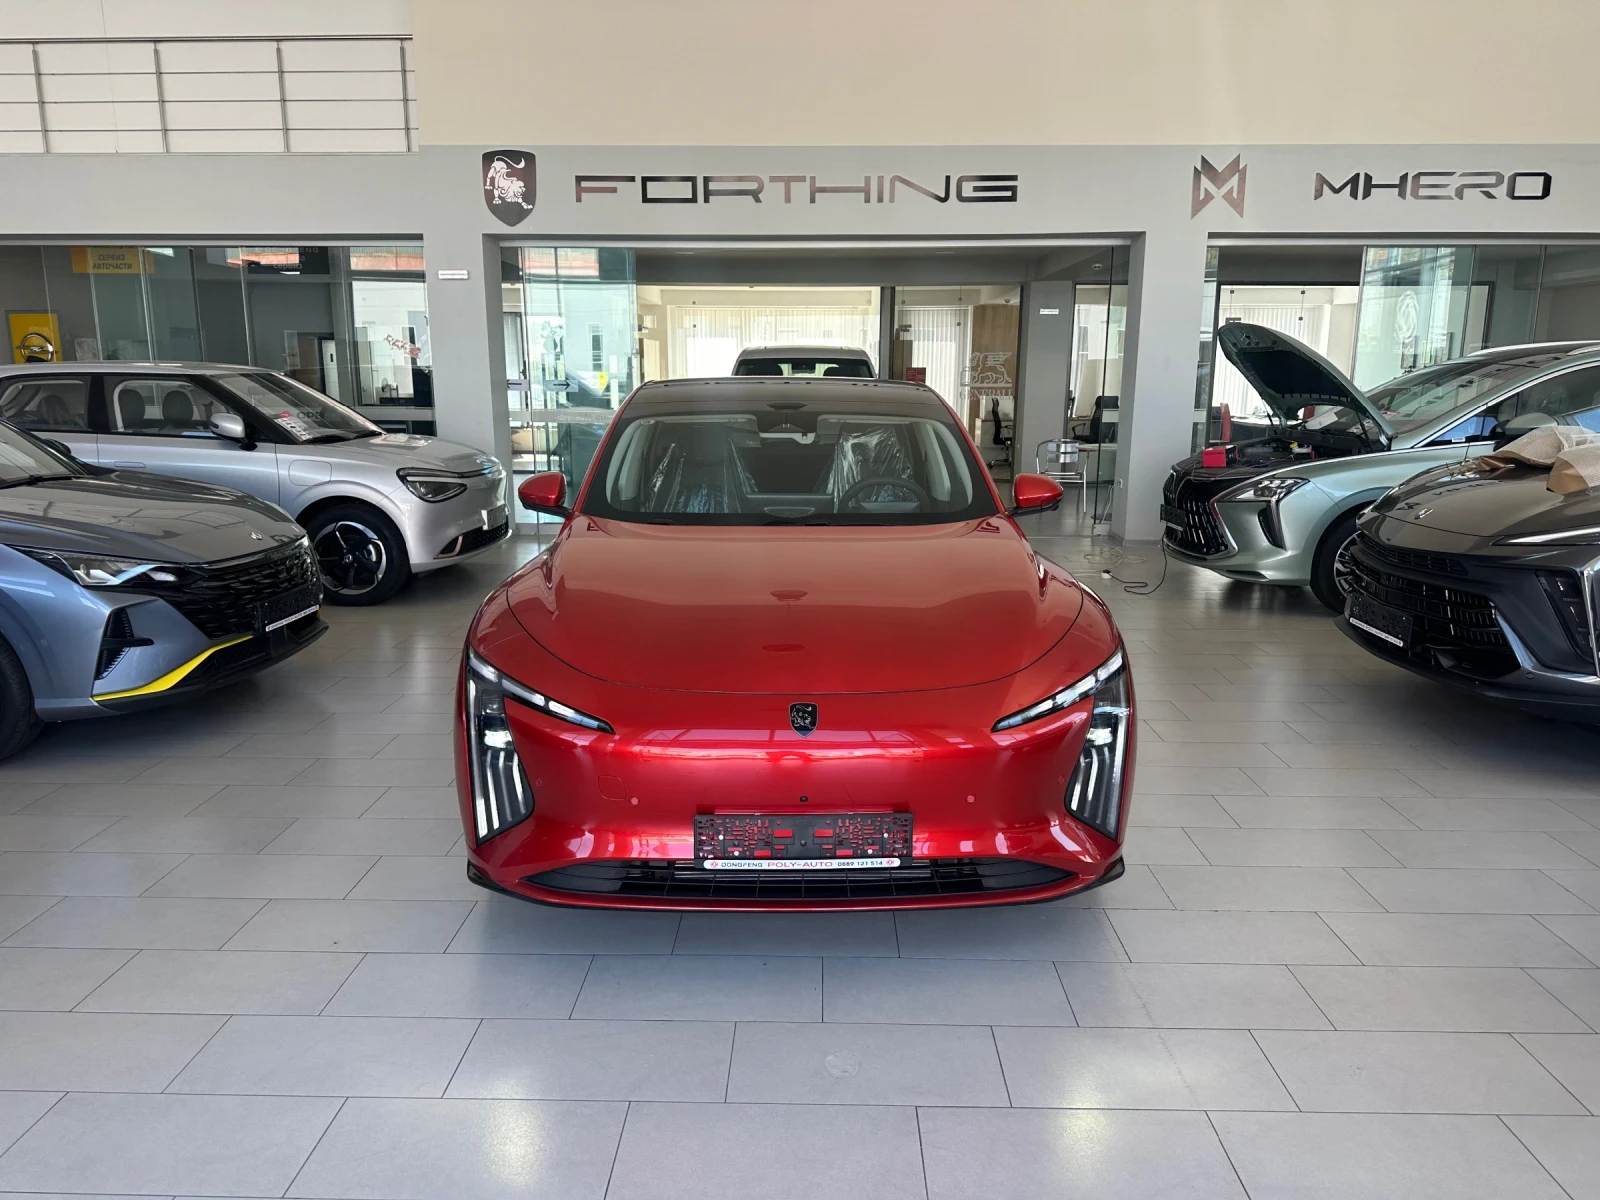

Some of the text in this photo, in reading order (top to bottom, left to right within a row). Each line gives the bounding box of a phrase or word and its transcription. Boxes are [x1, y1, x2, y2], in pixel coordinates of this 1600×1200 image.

[575, 175, 1018, 204] FORTHING
[1313, 171, 1553, 201] MHERO
[92, 262, 133, 270] АВТОЧАСТИ
[97, 253, 126, 261] СЕРВИЗ
